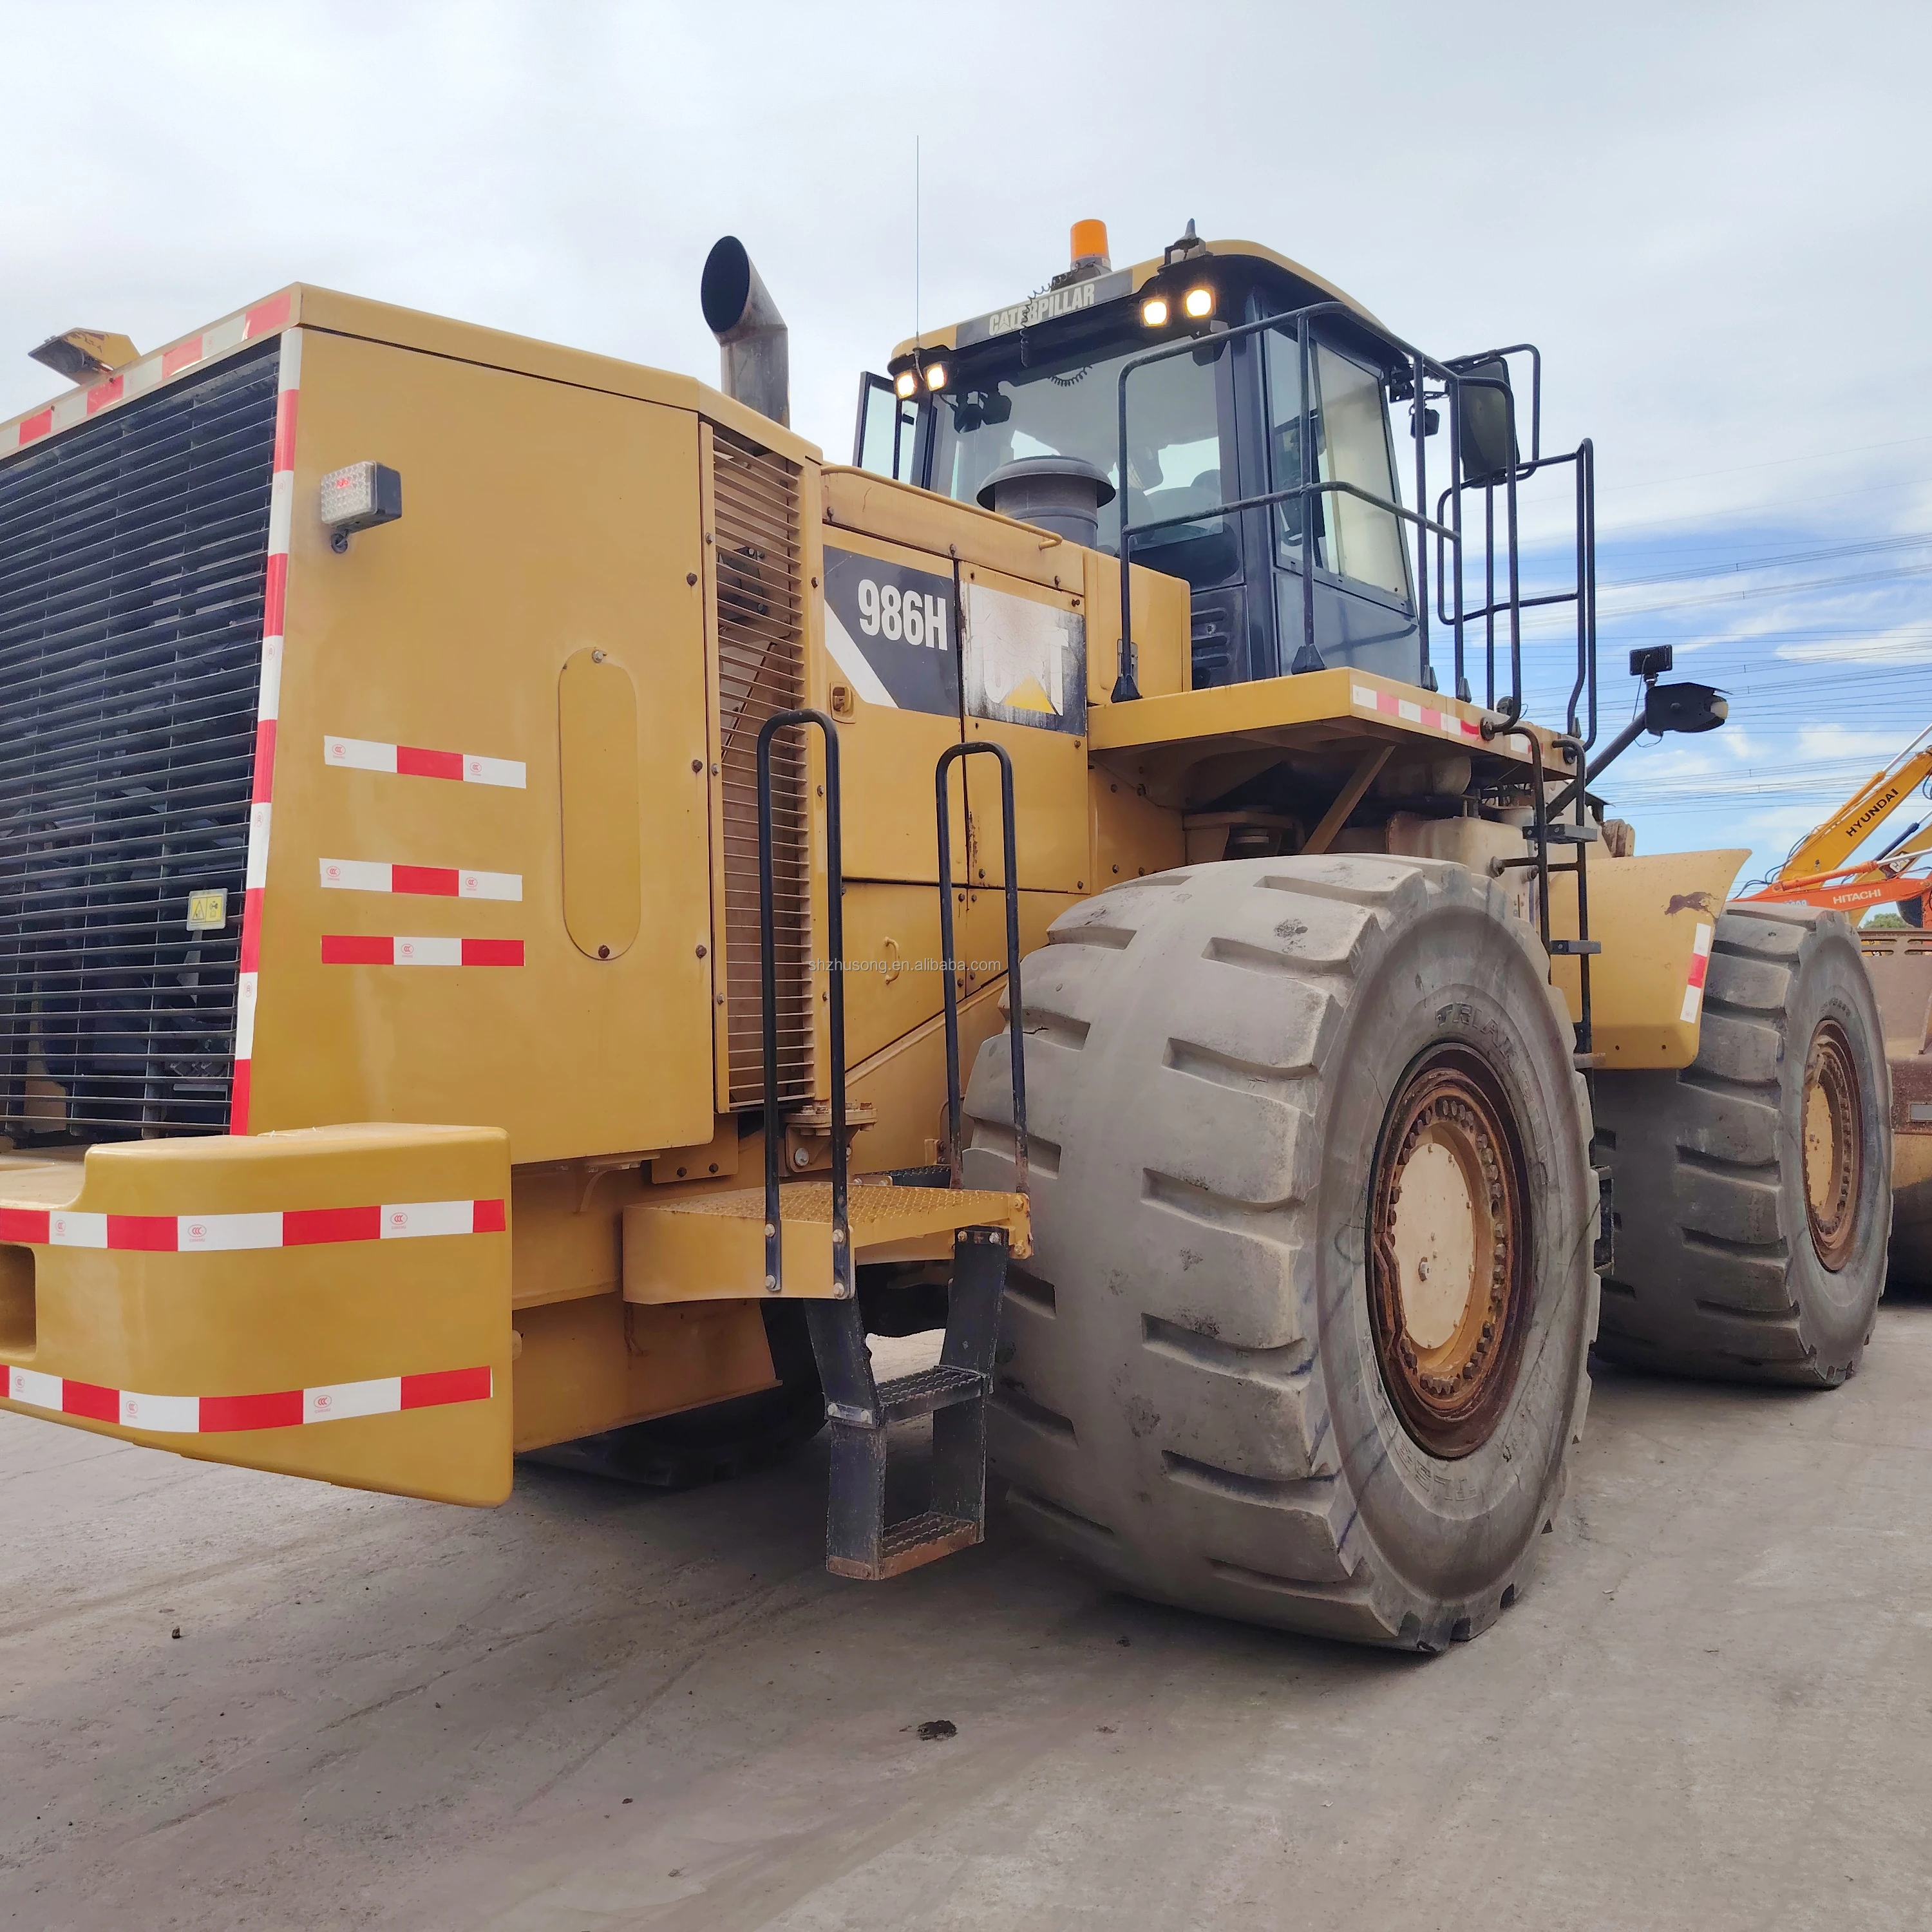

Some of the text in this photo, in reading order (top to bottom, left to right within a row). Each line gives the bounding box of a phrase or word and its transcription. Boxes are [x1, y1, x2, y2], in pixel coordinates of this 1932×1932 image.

[989, 283, 1095, 336] CATERPILLAR
[858, 579, 948, 651] 986H
[1846, 788, 1899, 837] HYUNDAI
[1833, 889, 1881, 904] HITACHI
